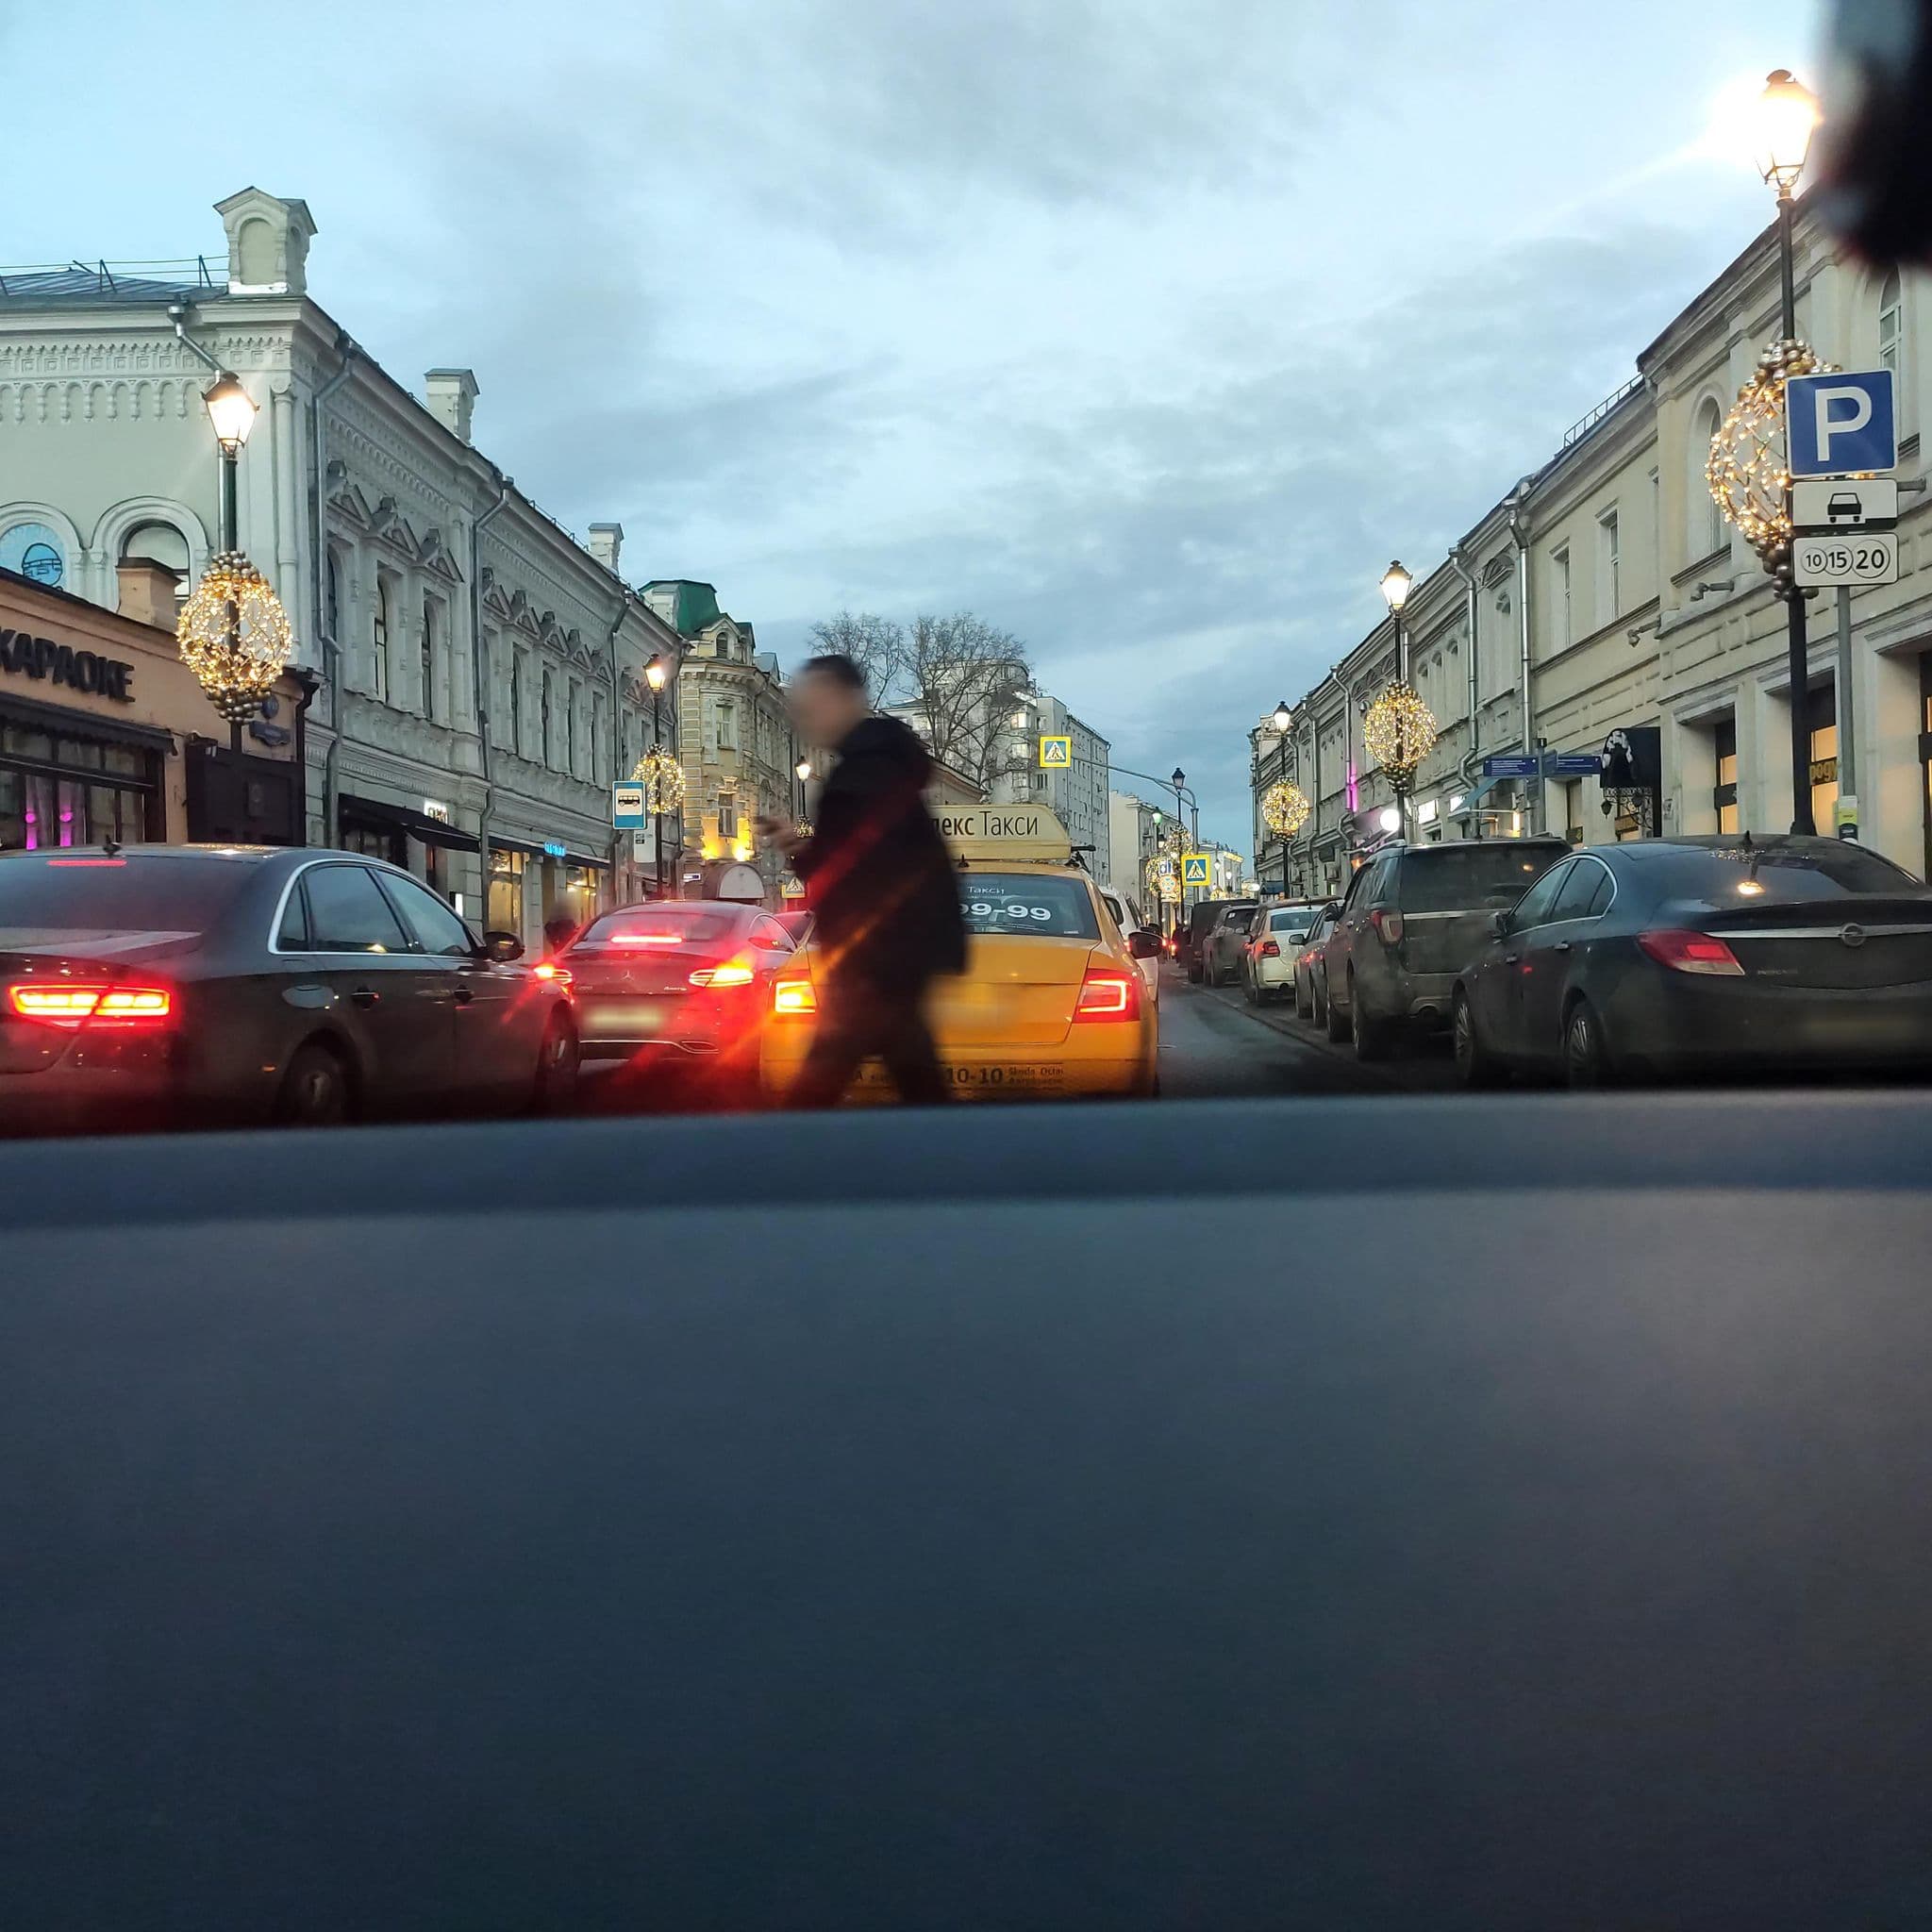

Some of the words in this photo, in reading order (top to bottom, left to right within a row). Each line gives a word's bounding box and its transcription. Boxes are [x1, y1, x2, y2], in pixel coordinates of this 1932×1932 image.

[1815, 386, 1872, 462] P
[1806, 554, 1822, 567] 10
[1828, 551, 1847, 568] 15
[1856, 549, 1885, 569] 20
[979, 810, 1038, 837] Такси
